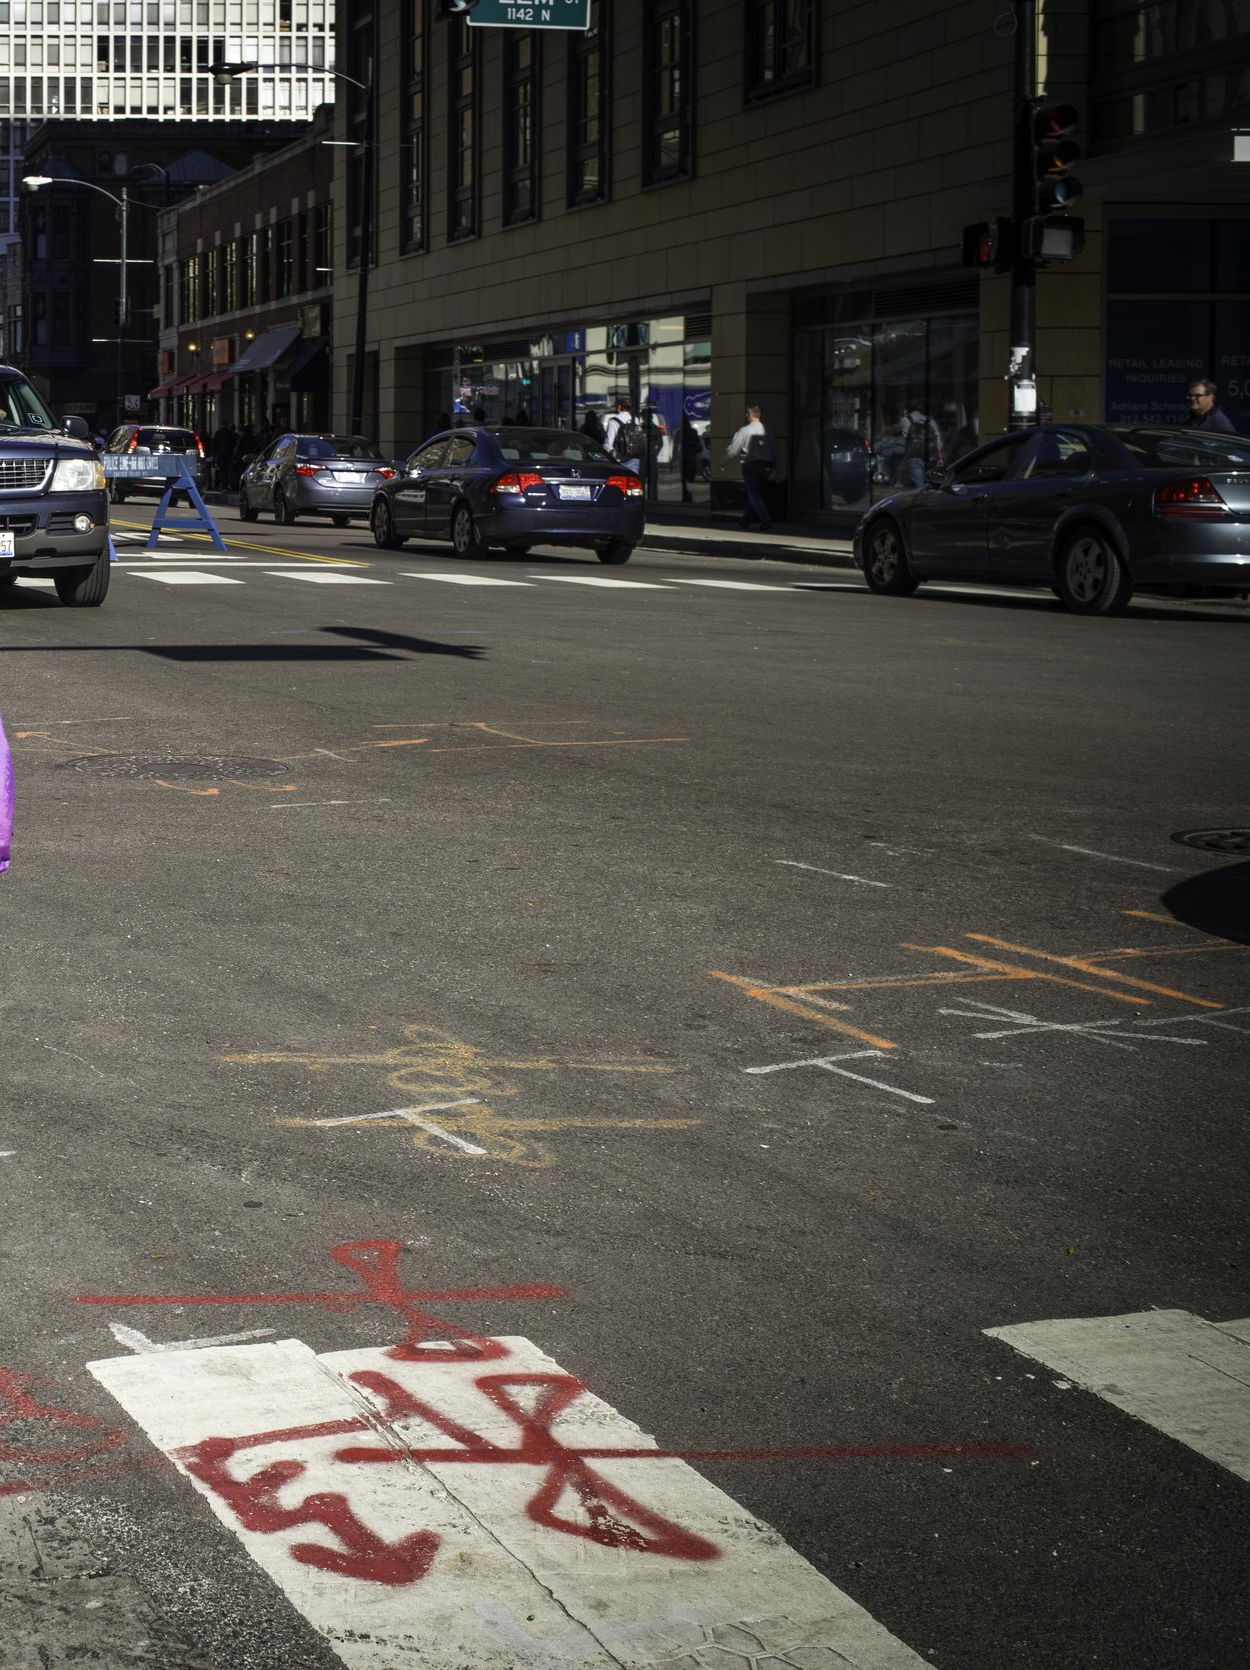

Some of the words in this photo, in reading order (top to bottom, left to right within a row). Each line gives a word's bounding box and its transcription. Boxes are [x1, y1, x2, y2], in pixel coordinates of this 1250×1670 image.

[507, 8, 533, 20] 1142
[541, 9, 550, 21] N
[1109, 358, 1149, 369] RETAIL
[1153, 358, 1204, 369] LEASING
[1125, 373, 1187, 384] INQUIRIES
